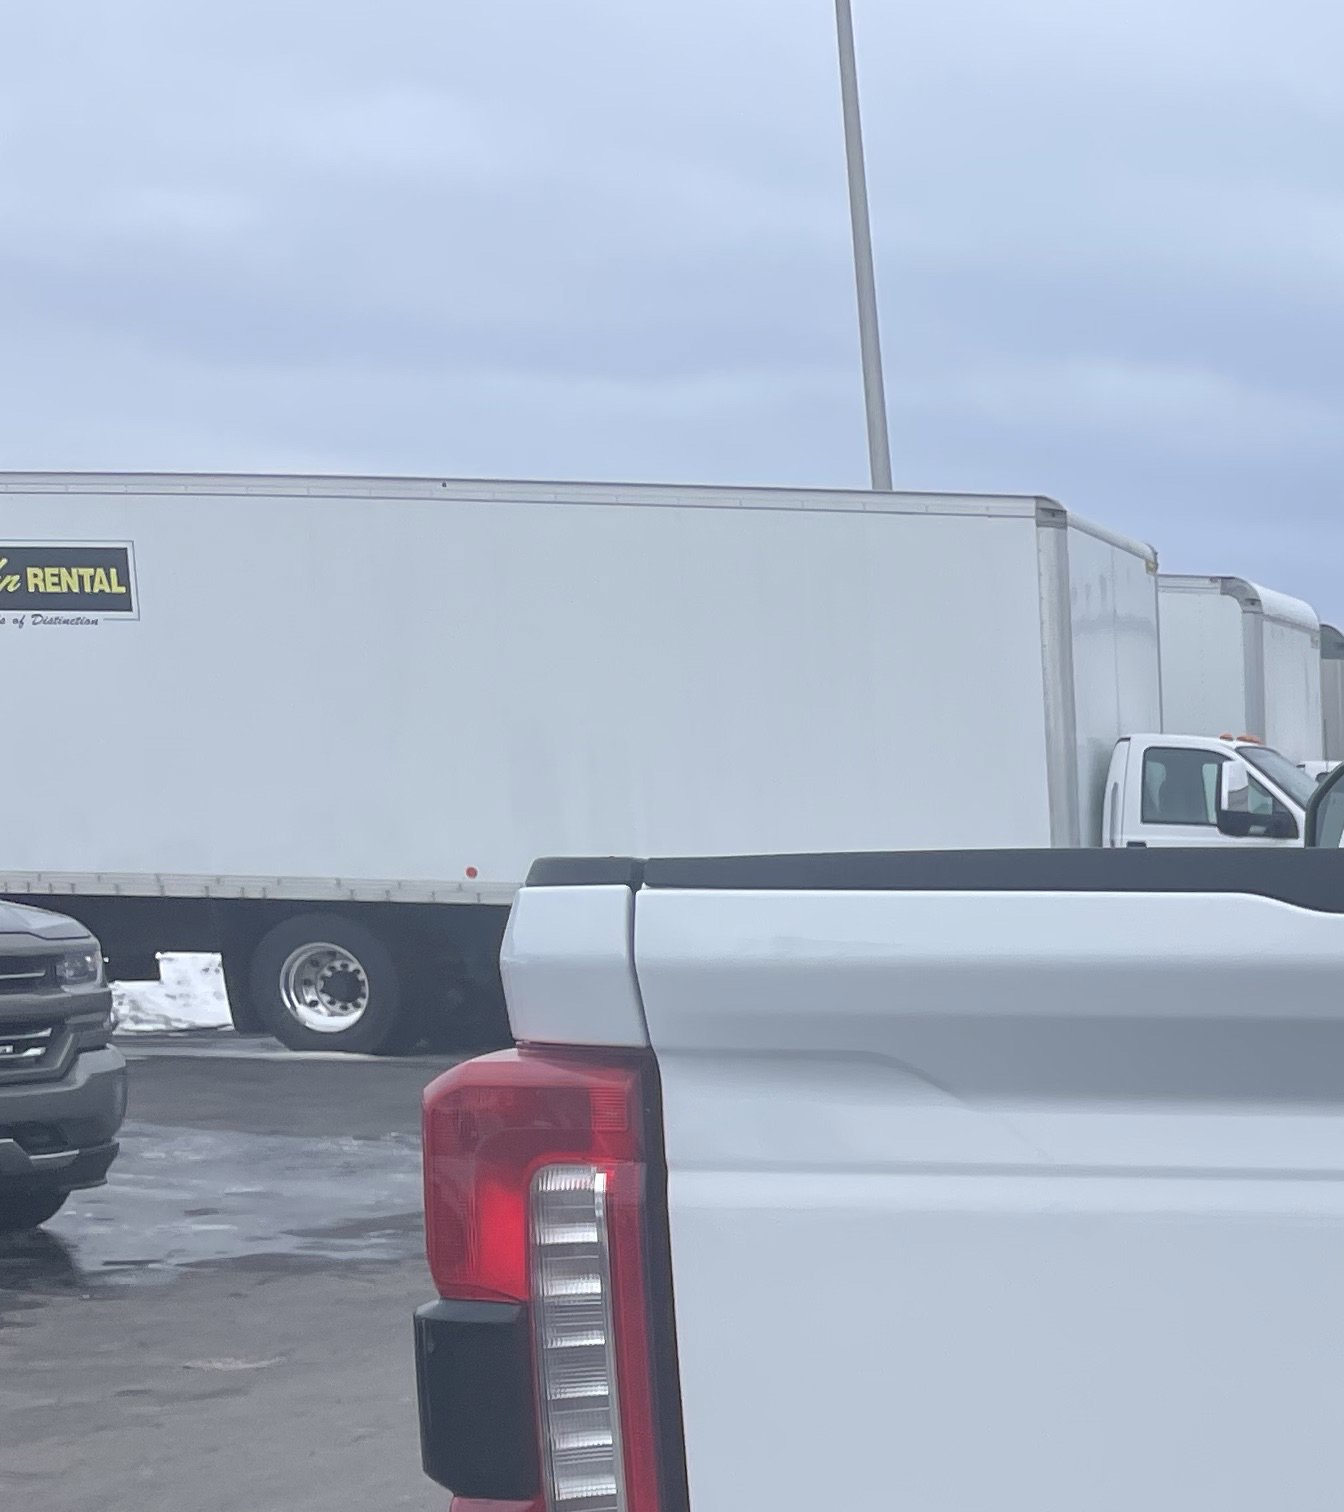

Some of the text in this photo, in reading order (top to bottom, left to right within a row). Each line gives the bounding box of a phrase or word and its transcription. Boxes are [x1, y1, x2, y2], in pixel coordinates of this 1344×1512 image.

[26, 567, 126, 593] RENTAL
[12, 614, 26, 629] of
[31, 613, 99, 626] Distinction
